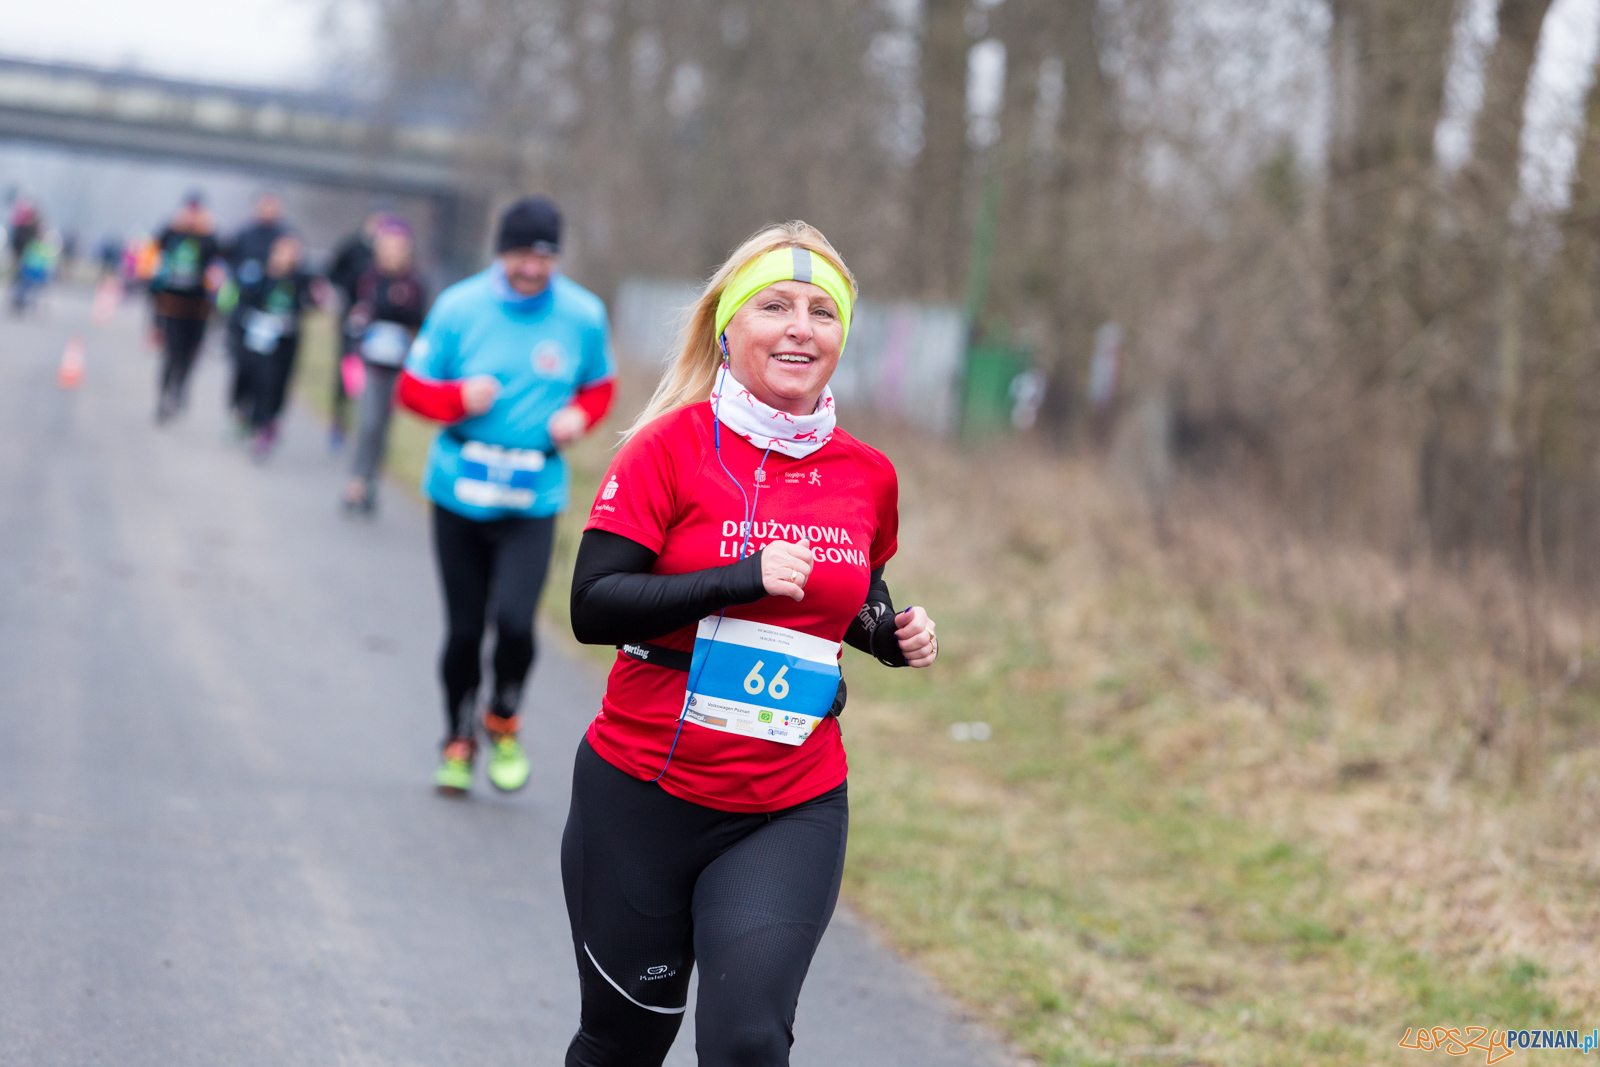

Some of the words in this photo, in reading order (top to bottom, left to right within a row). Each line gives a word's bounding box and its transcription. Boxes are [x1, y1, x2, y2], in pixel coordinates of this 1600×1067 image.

[722, 519, 853, 545] DRUŻYNOWA
[811, 546, 868, 568] GOWA
[743, 659, 790, 700] 66
[707, 702, 734, 712] Volkswagen
[790, 716, 806, 726] mjp
[639, 970, 676, 981] Kalenji
